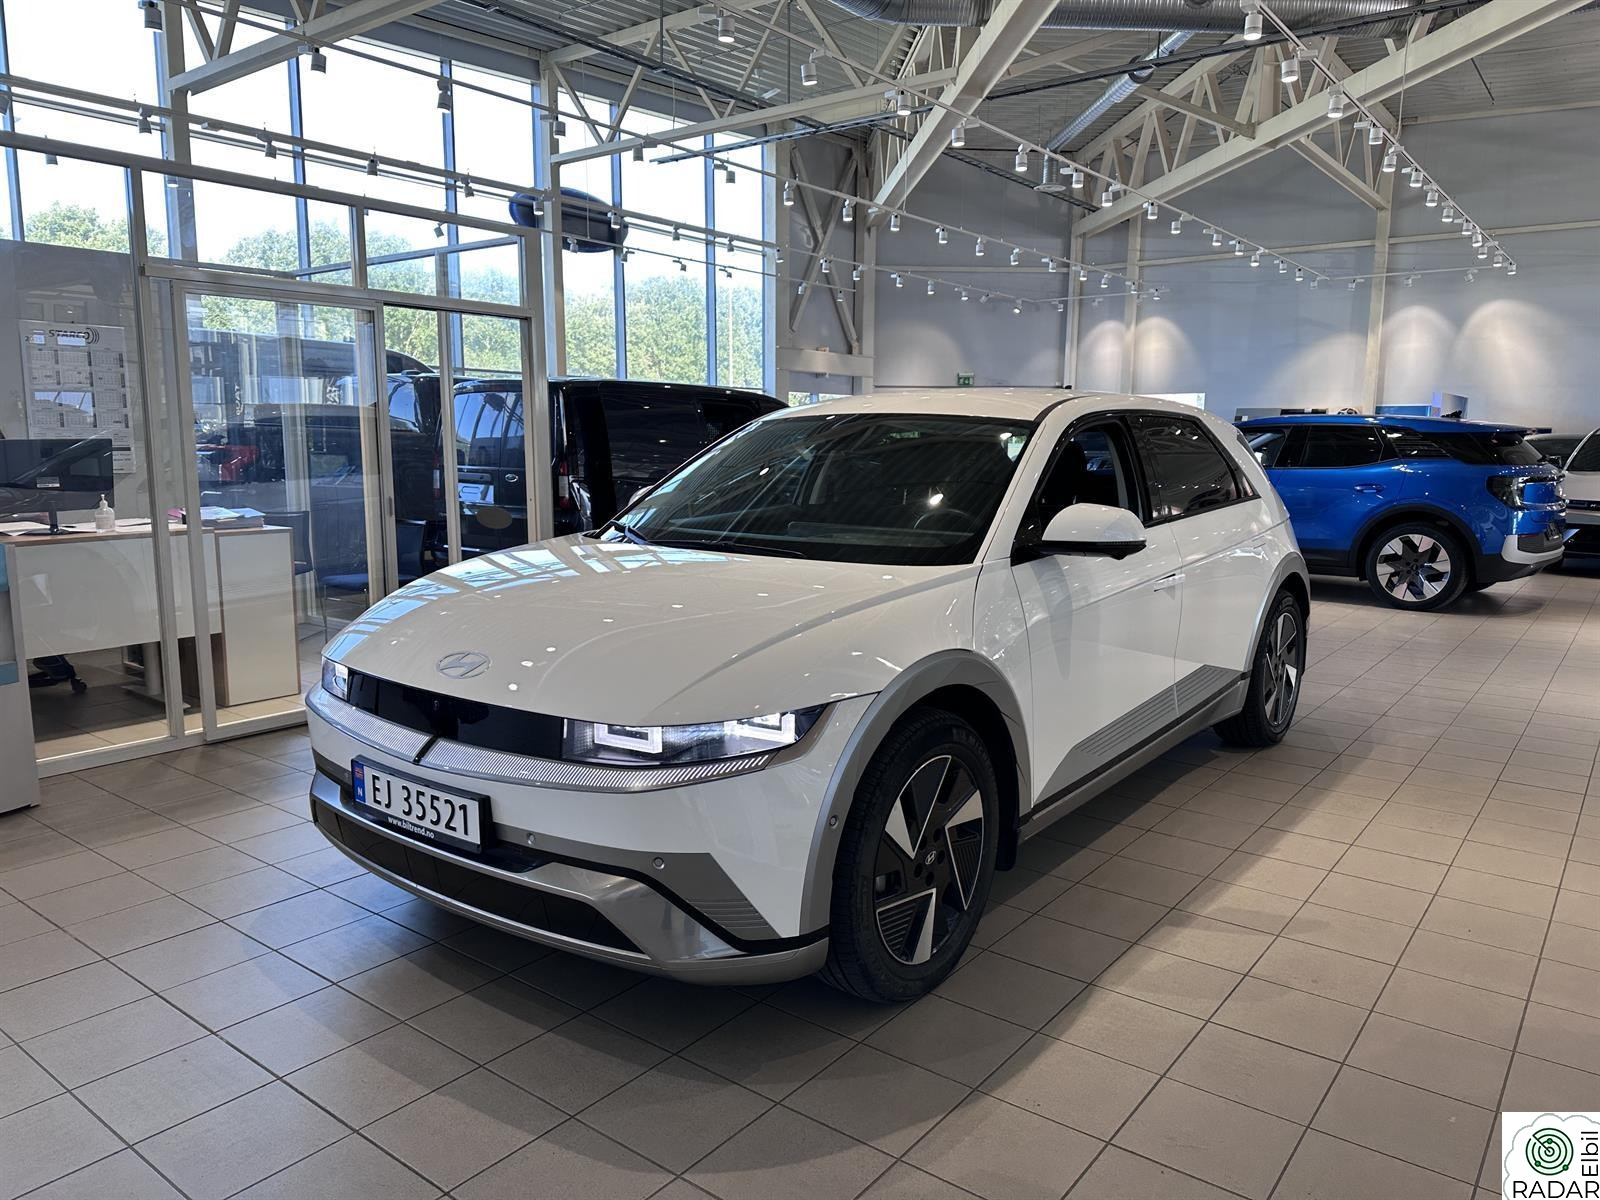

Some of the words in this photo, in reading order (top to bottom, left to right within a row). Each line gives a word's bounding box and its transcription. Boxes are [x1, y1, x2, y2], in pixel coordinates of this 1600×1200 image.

[357, 786, 363, 797] N
[372, 774, 392, 809] EJ
[401, 785, 469, 836] 35521
[388, 816, 435, 839] www.biltrend.no
